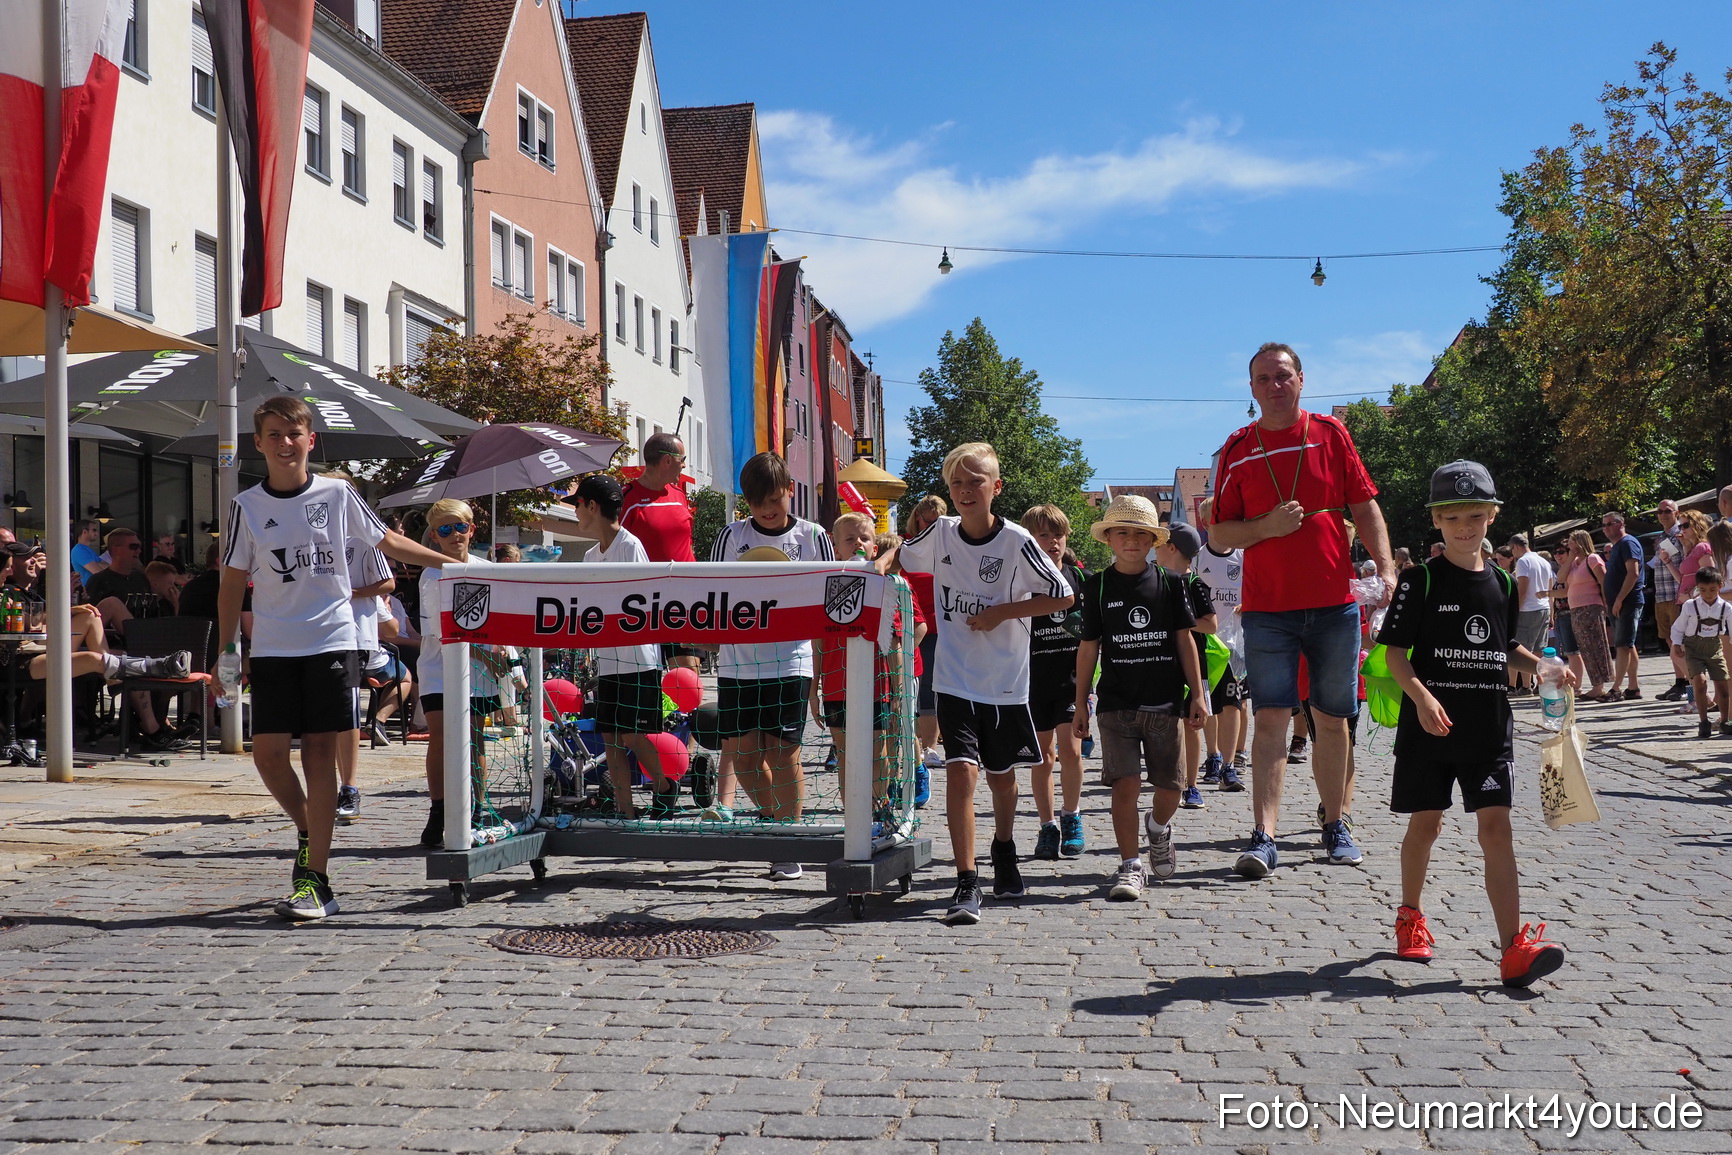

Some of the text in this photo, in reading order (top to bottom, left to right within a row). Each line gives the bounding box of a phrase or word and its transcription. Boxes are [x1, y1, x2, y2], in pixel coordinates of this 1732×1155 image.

[857, 440, 872, 454] H
[295, 547, 334, 568] fuchs
[1215, 590, 1238, 602] fuchs
[464, 595, 488, 628] TSV
[835, 587, 862, 622] TSV
[955, 594, 991, 616] fuch
[1107, 600, 1124, 609] JAKO
[1438, 604, 1460, 612] JAKO
[534, 591, 778, 635] Die Siedler
[1434, 647, 1508, 663] NÜRNBERGER
[1446, 661, 1503, 671] VERSICHERUNG
[1426, 679, 1477, 690] Generalagentur
[1479, 682, 1494, 690] Merl
